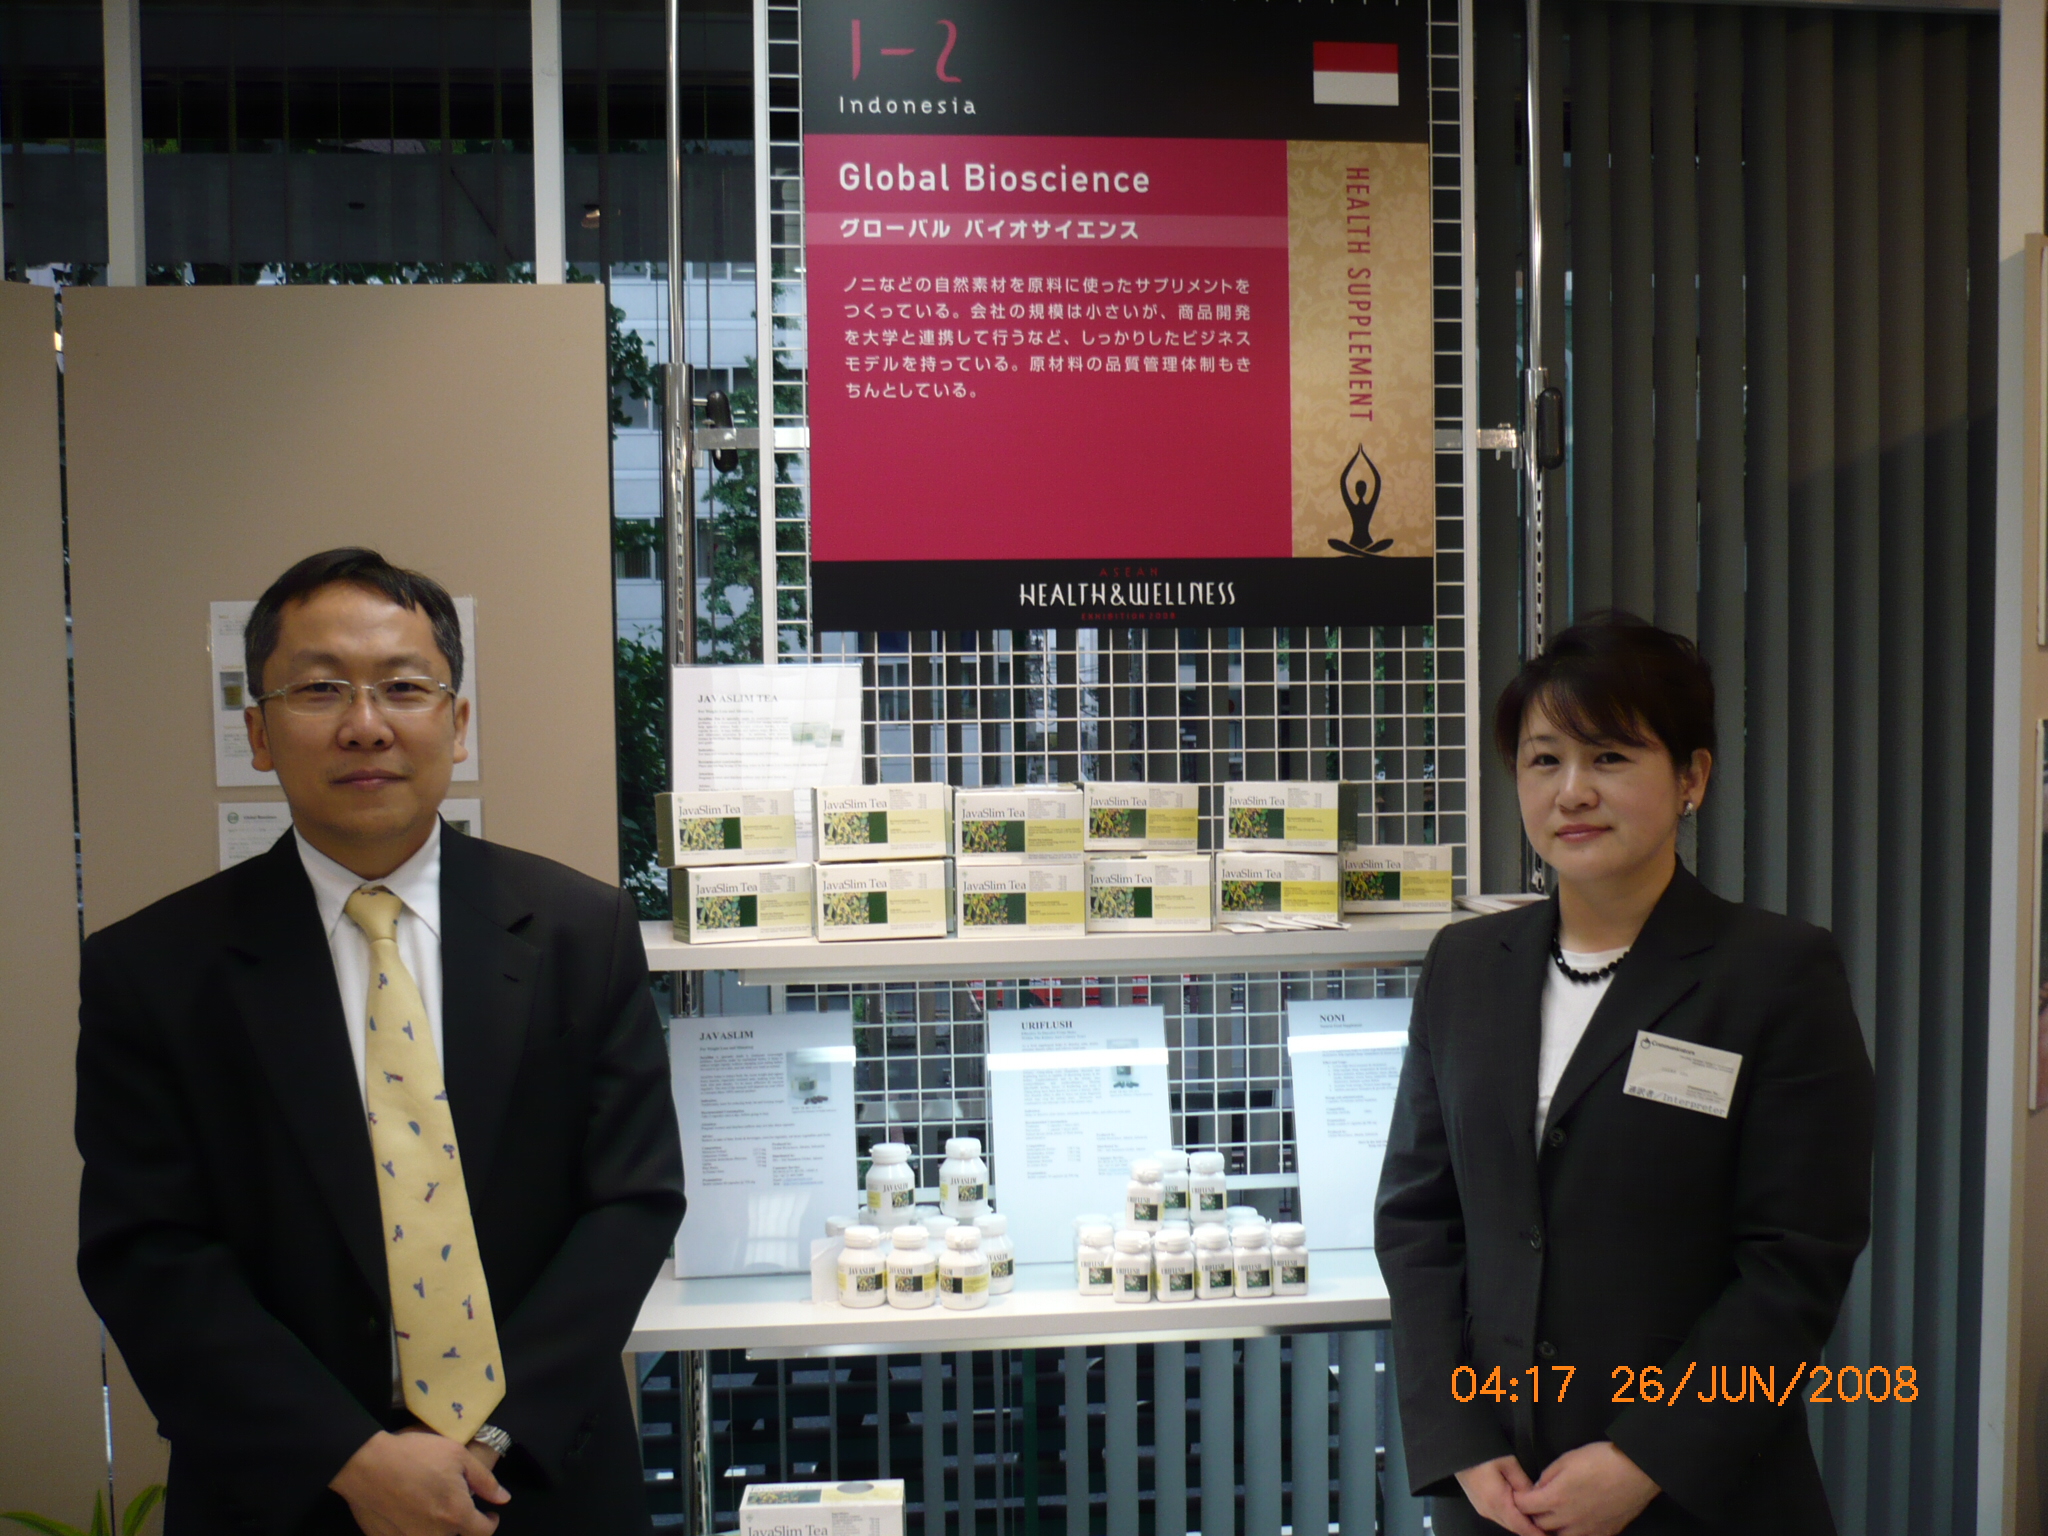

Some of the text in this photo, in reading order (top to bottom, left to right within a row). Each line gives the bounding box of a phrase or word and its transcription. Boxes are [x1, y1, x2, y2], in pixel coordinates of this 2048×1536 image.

[839, 95, 976, 115] Indonesia
[839, 162, 1149, 193] Global Bioscience
[840, 218, 1139, 240] グローバル バイオサイエンス
[843, 276, 1250, 295] ノニなどの自然素材を原料に使ったサプリメントを
[1346, 167, 1373, 422] HEALTH SUPPLEMENT
[844, 302, 1251, 321] つくっている。会社の規模は小さいが、商品開発
[844, 328, 1251, 347] を大学と連携して行うなど、しっかりしたビジネス
[845, 355, 1251, 373] モデルを持っている。原材料の品質管理体制もき
[845, 382, 978, 399] ちんとしている。
[1099, 566, 1159, 578] ASEAN
[1019, 582, 1236, 607] HEALTH&WELLNESS
[1081, 611, 1177, 621] EXHIBITION 2008
[697, 693, 779, 704] JAVASLIM TEA
[823, 798, 888, 811] JavaSlim Tea
[1090, 796, 1147, 807] JavaSlim Tea
[1228, 796, 1285, 807] JavaSlim Tea
[678, 803, 741, 817] JavaSlim Tea
[962, 807, 1026, 820] JavaSlim Tea
[1345, 859, 1401, 871] JavaSlim Tea
[1090, 873, 1153, 885] JavaSlim Tea
[1222, 868, 1282, 879] JavaSlim Tea
[696, 882, 758, 895] JavaSlim Tea
[823, 878, 888, 892] JavaSlim Tea
[963, 880, 1027, 892] JavaSlim Tea
[1319, 1014, 1346, 1023] NONI
[1021, 1020, 1073, 1031] URIFLUSH
[699, 1030, 754, 1041] JAVASLIM
[950, 1177, 977, 1185] JAVASLIM
[848, 1266, 876, 1276] JAVASLIM
[804, 1524, 828, 1536] Tea
